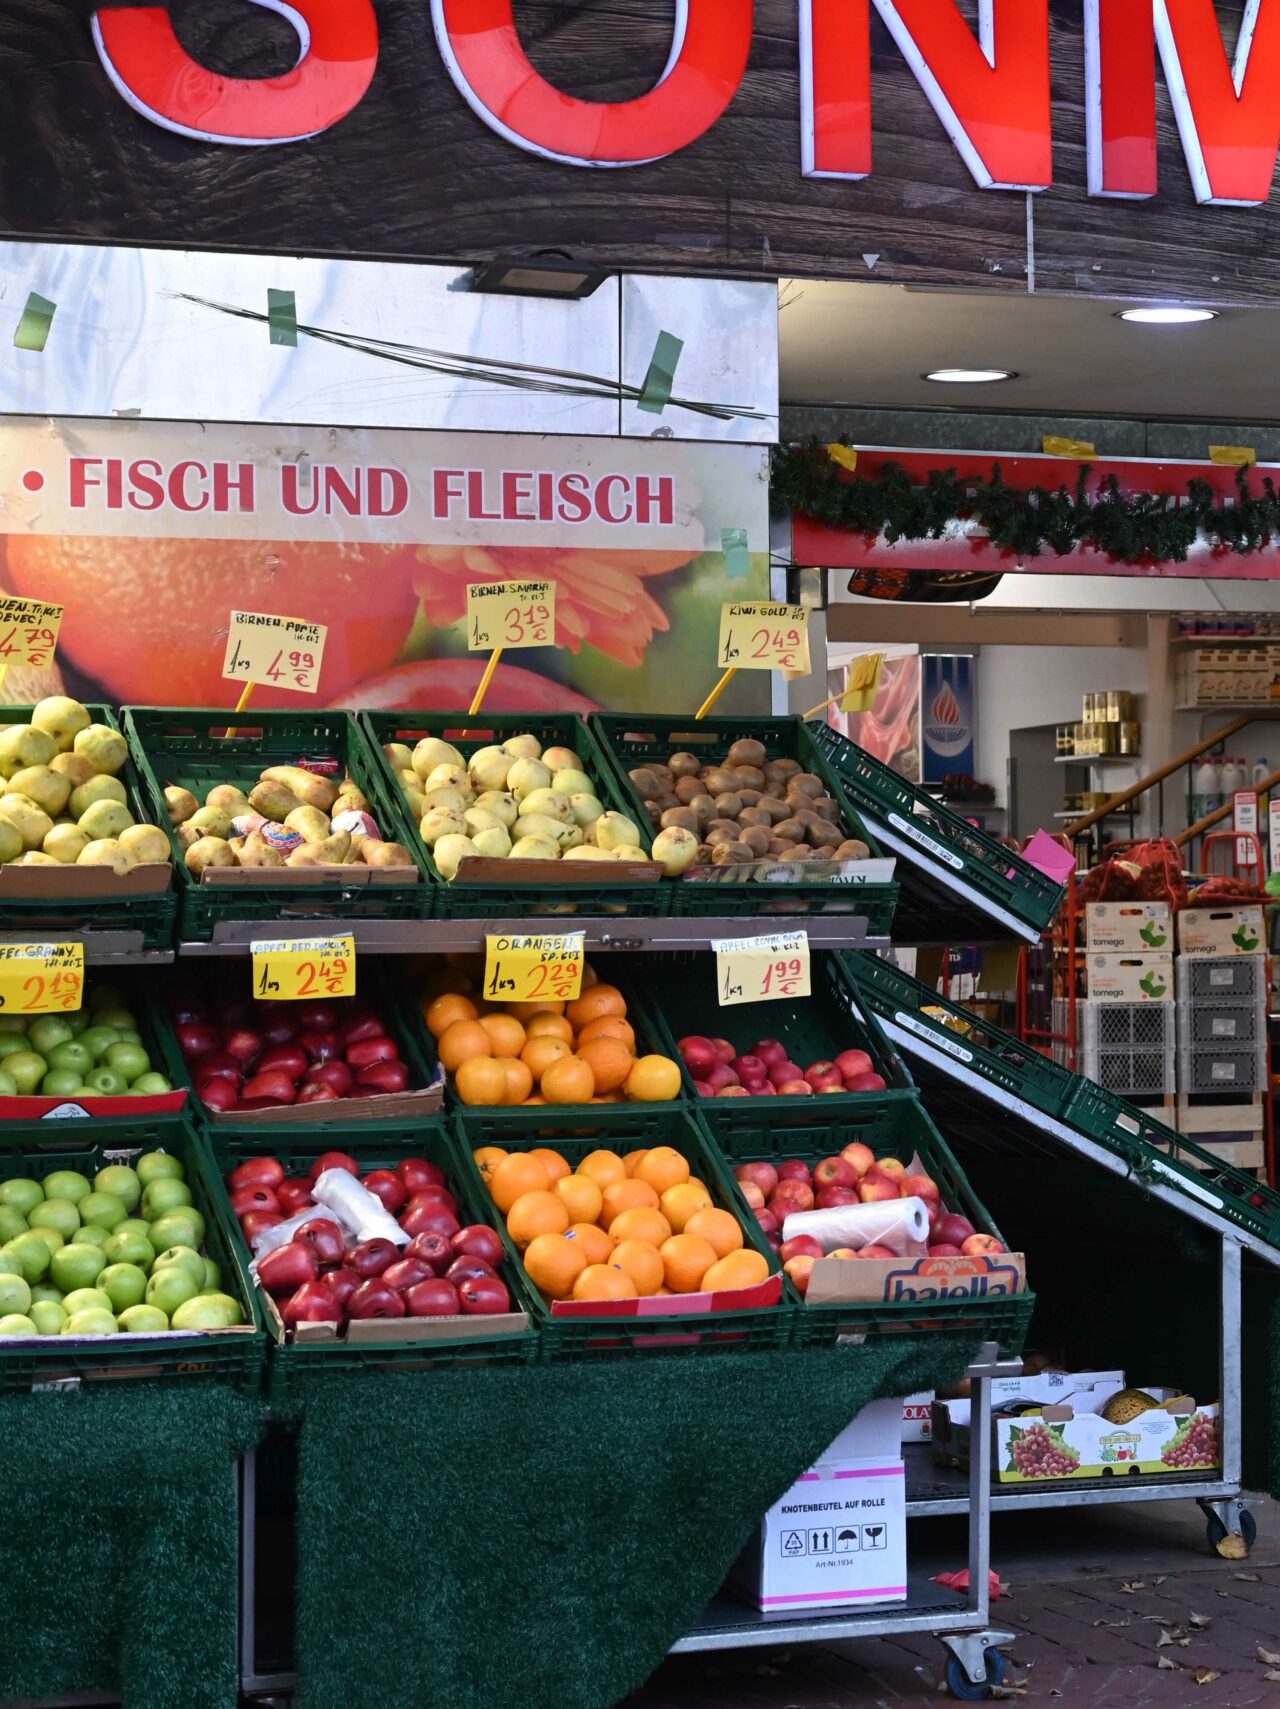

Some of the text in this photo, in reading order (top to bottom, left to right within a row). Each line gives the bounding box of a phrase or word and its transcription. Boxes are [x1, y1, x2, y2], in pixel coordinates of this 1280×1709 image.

[70, 457, 674, 525] FISCH UND FLEISCH
[1093, 938, 1124, 947] tomega
[1185, 944, 1217, 954] tomega
[1092, 989, 1124, 998] tomega
[781, 1497, 886, 1514] KNOTENBEUTEL AUF ROLLE
